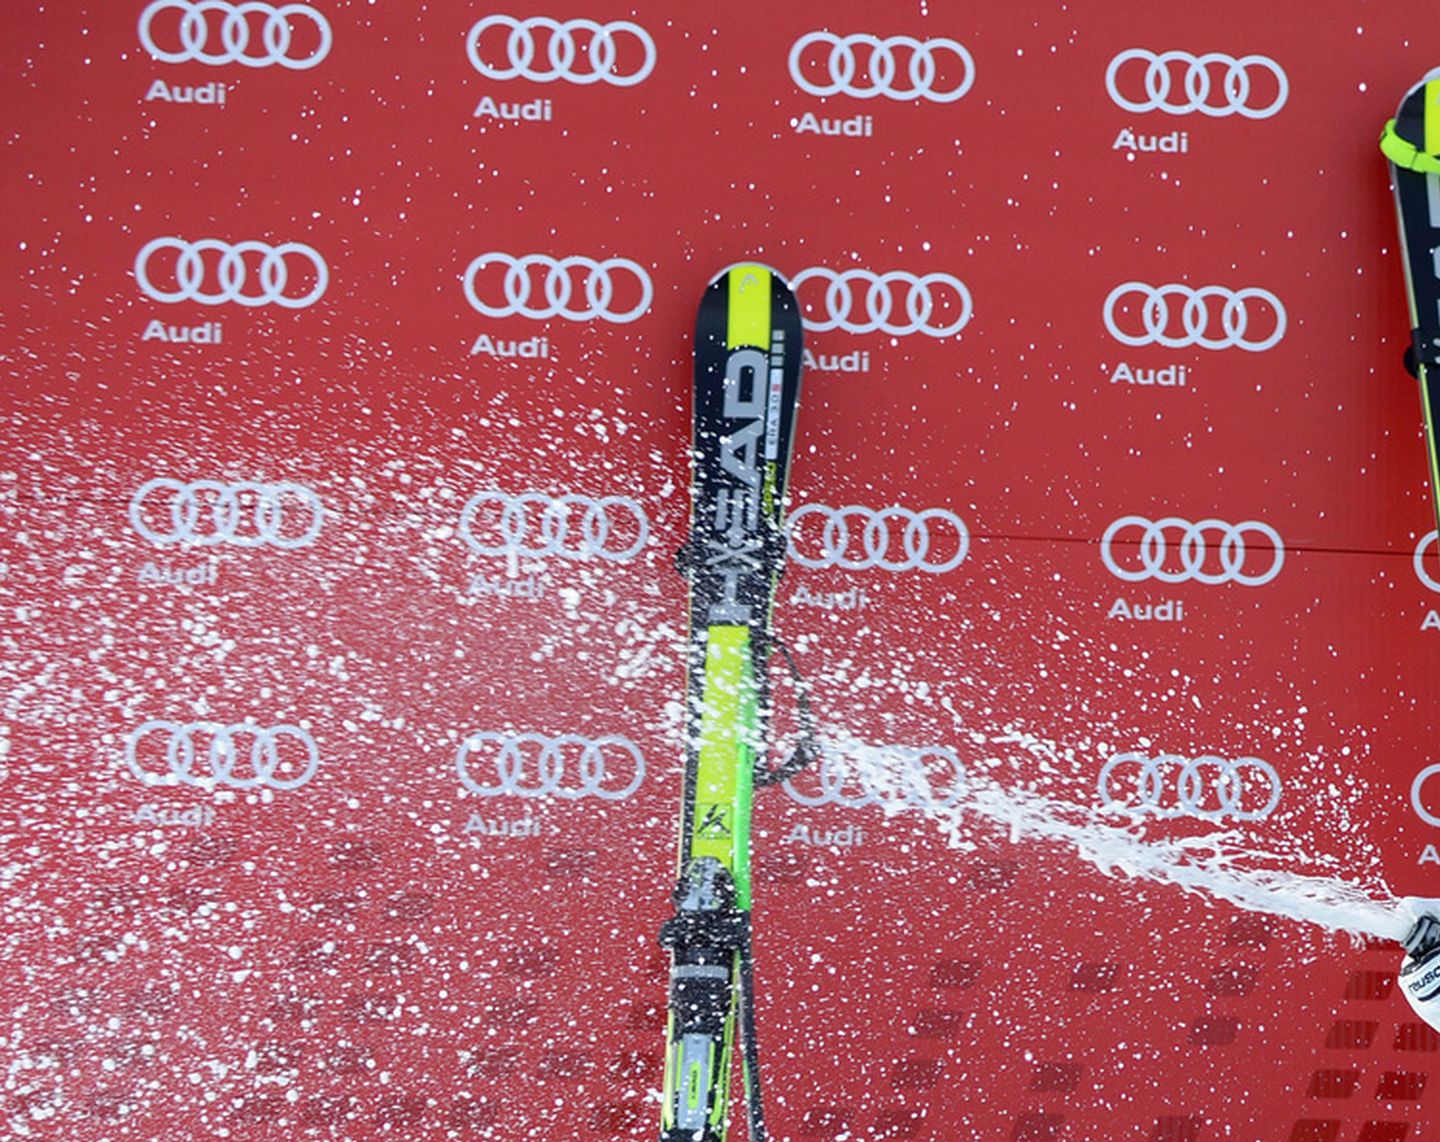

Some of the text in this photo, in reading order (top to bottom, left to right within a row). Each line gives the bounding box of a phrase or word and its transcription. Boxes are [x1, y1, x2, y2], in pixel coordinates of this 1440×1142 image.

[145, 79, 226, 105] Audi
[473, 96, 552, 122] Audi
[795, 112, 873, 137] Audi
[1112, 128, 1188, 153] Audi
[141, 319, 222, 345] Audi
[470, 333, 549, 359] Audi
[801, 348, 870, 373] Audi
[1109, 362, 1186, 387] Audi
[791, 585, 868, 610] Audi
[1107, 597, 1184, 622] Audi
[134, 804, 215, 826] Audi
[464, 813, 542, 837] Audi
[787, 823, 865, 846] Audi
